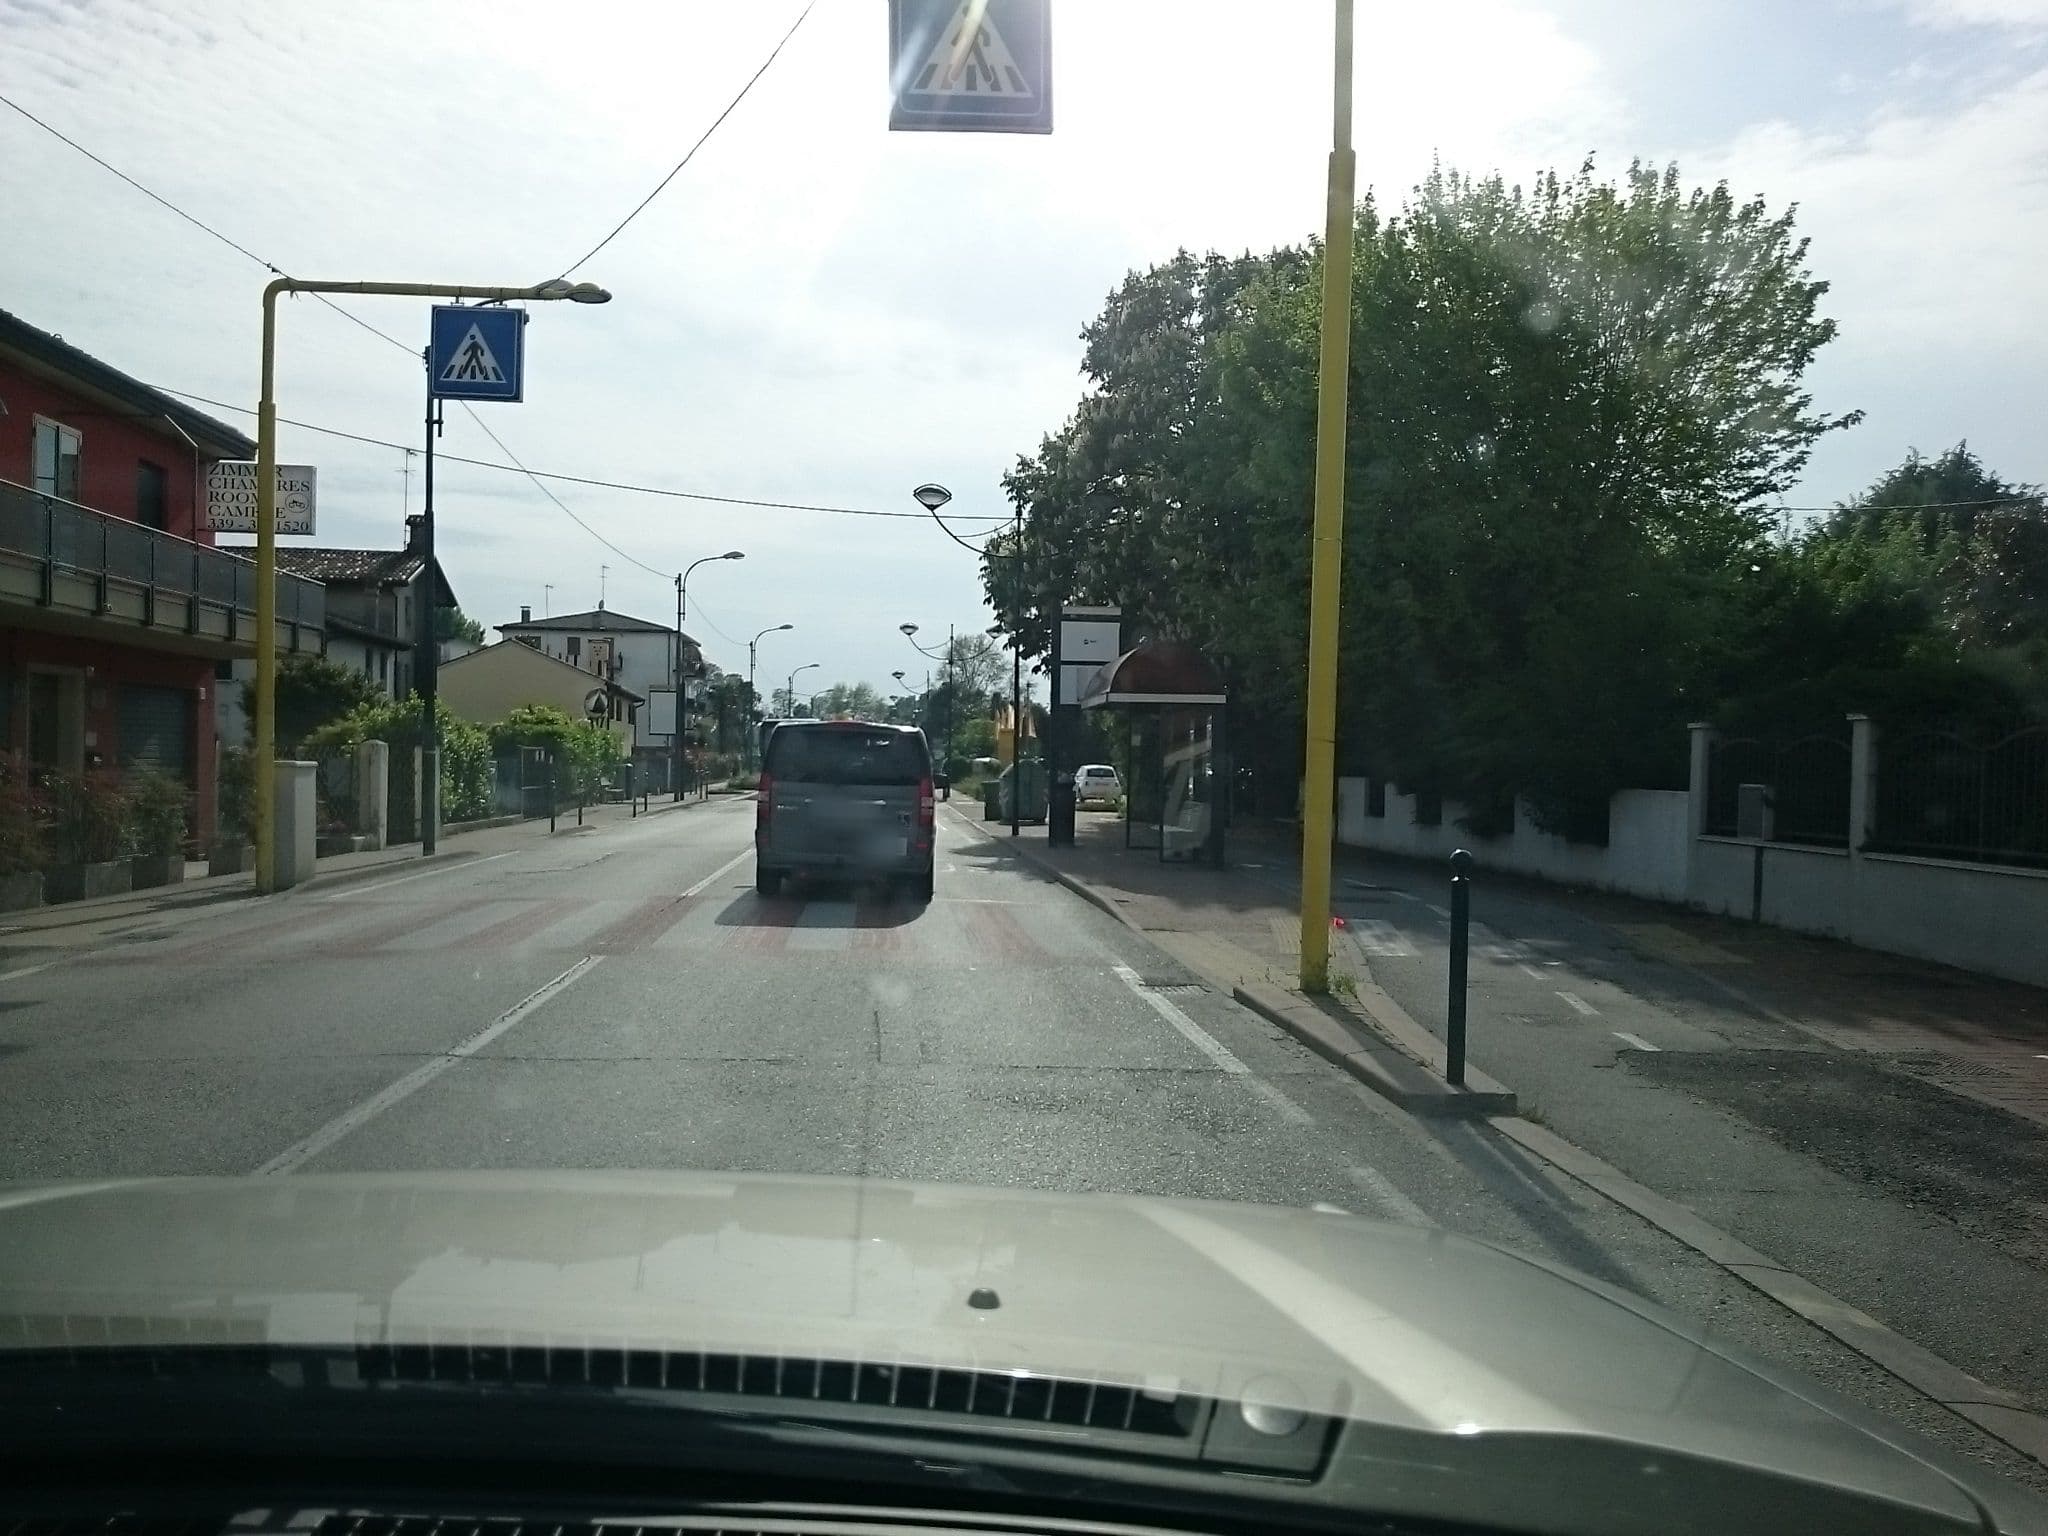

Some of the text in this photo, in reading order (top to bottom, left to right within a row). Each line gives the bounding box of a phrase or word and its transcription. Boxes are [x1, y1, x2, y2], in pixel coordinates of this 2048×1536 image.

[209, 464, 282, 477] ZIMMR
[208, 477, 310, 491] CHAMRES
[208, 504, 286, 518] CAMEE
[207, 518, 234, 529] 339
[248, 519, 309, 531] 31520
